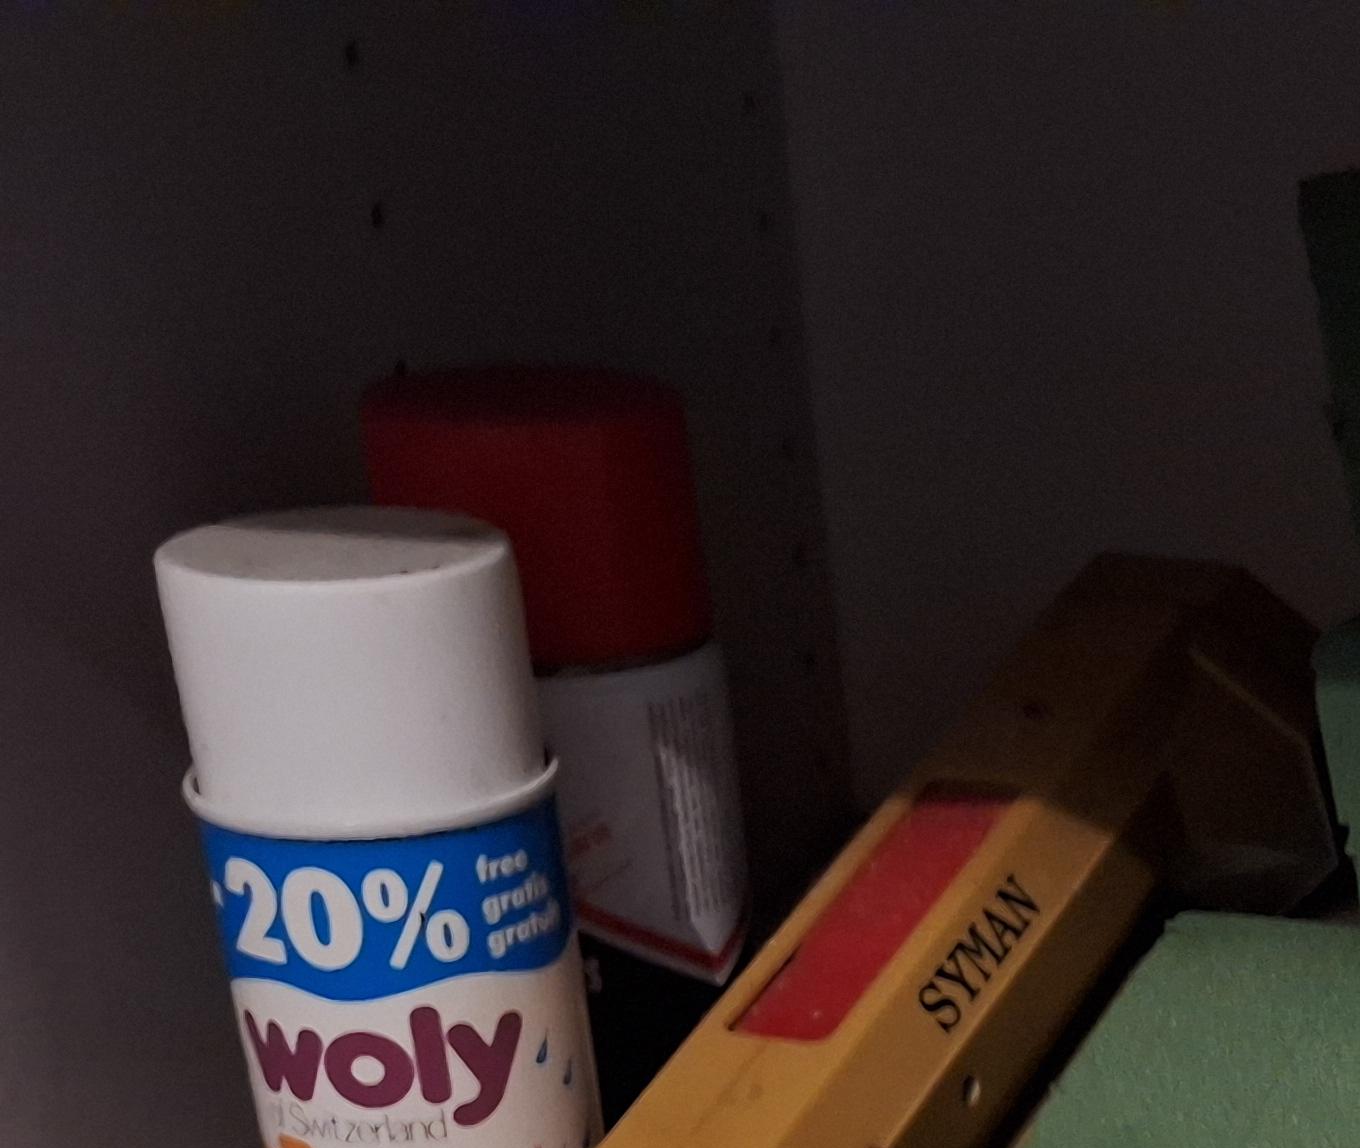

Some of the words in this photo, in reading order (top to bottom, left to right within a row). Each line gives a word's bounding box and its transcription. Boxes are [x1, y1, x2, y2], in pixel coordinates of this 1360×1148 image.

[476, 848, 529, 884] free
[918, 873, 1041, 1033] SYMAN
[244, 1006, 523, 1126] woly
[289, 1102, 449, 1142] Switzerland
